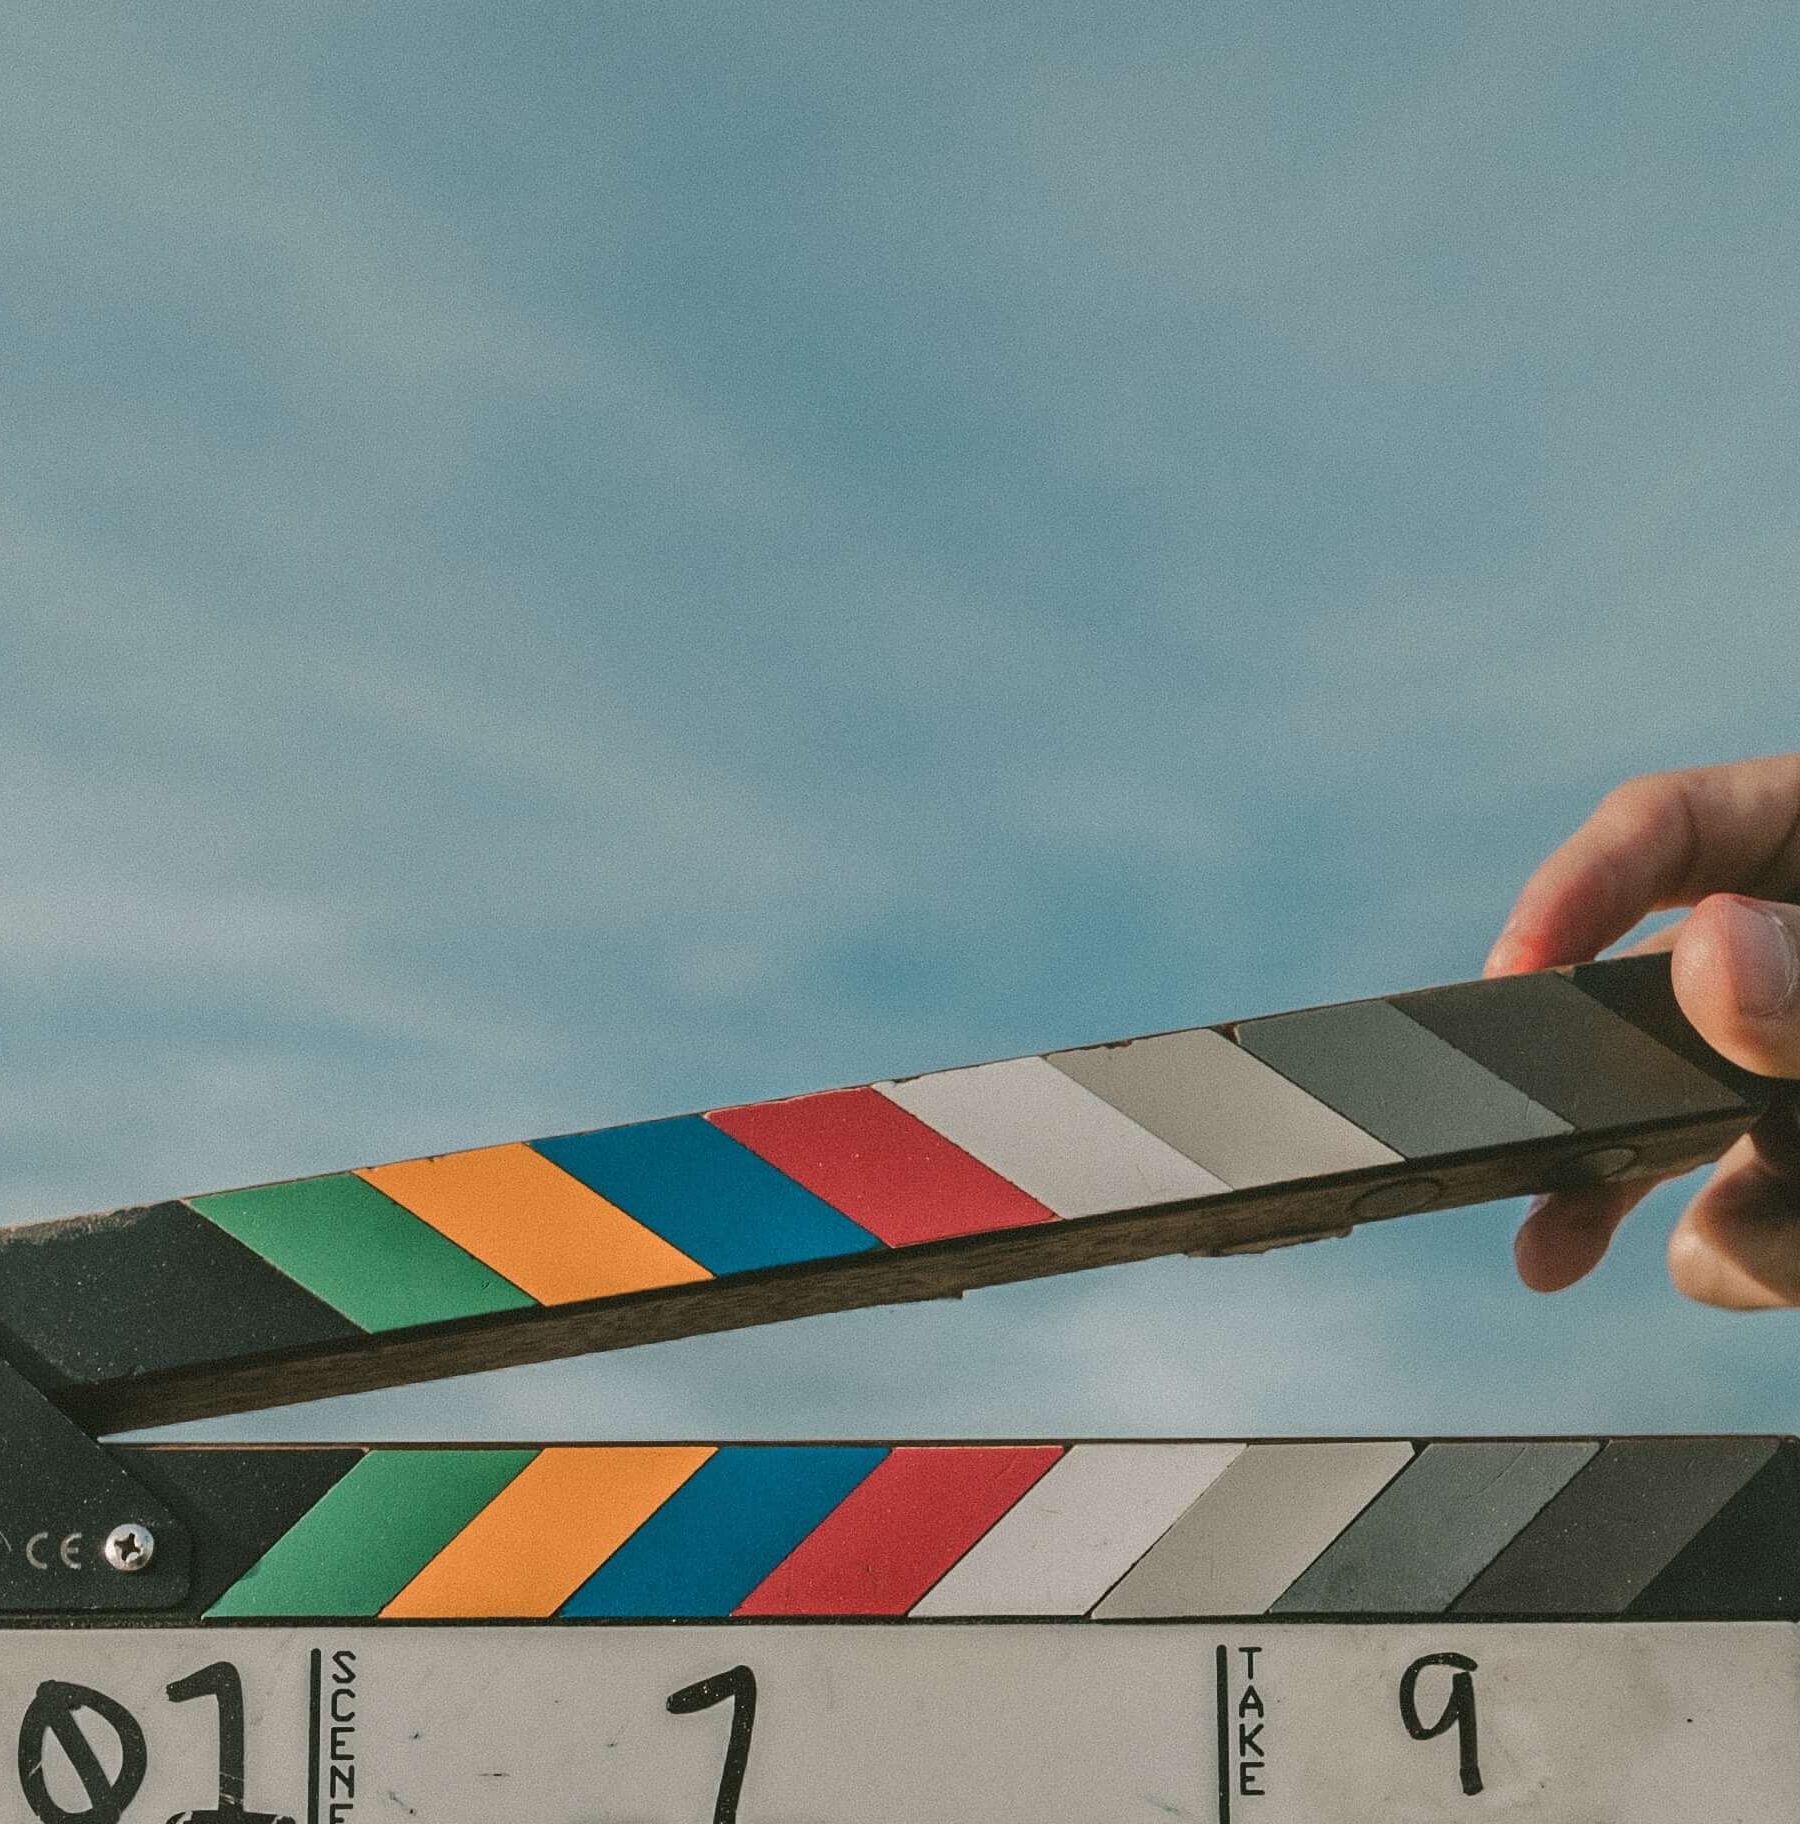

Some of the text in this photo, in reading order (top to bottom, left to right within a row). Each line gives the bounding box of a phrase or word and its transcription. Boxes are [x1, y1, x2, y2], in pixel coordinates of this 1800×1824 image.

[25, 1531, 82, 1570] CE
[1238, 1646, 1266, 1796] TAKE
[1398, 1652, 1483, 1796] 9
